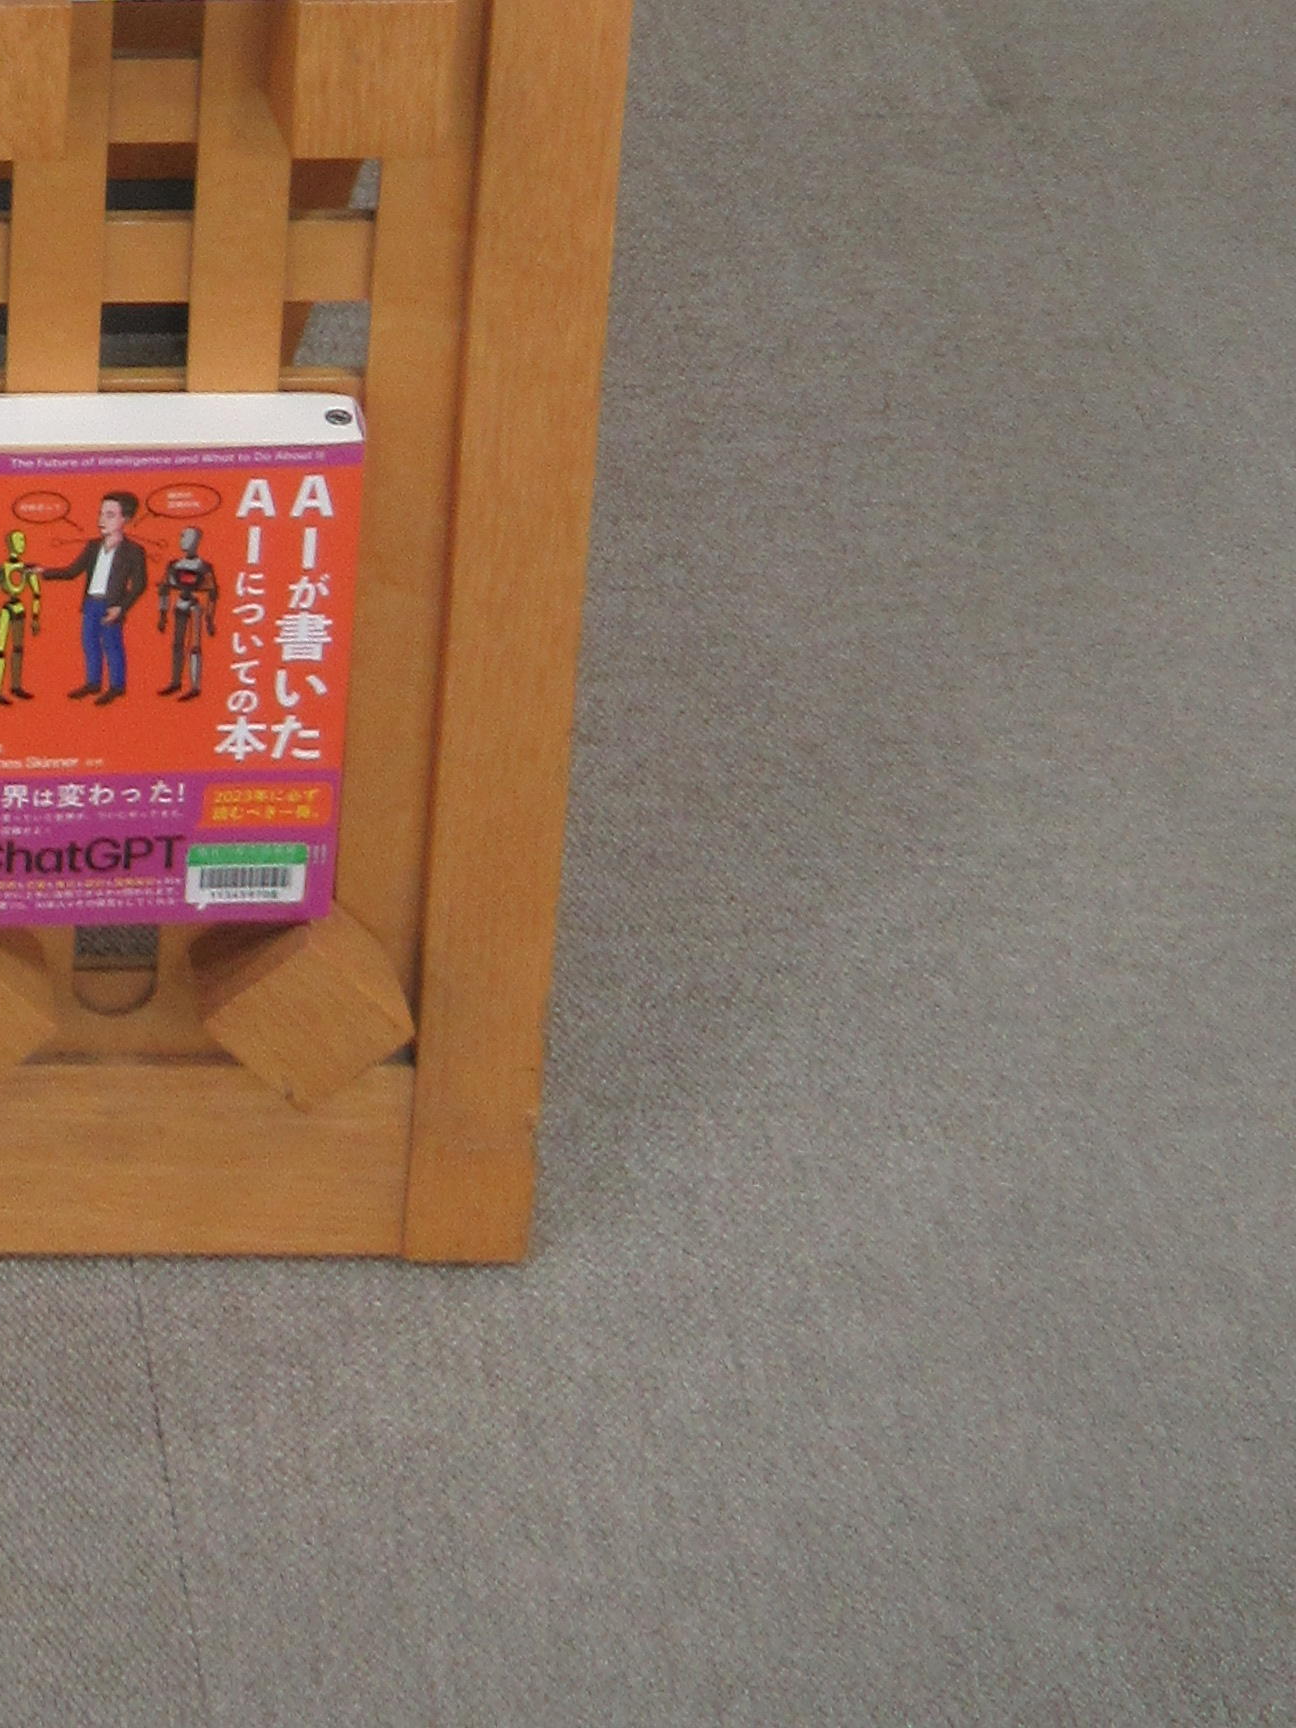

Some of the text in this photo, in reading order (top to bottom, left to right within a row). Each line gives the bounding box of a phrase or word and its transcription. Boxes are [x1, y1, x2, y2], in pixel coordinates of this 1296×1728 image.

[214, 478, 277, 762] AIについての本
[270, 474, 335, 760] AIが書いた
